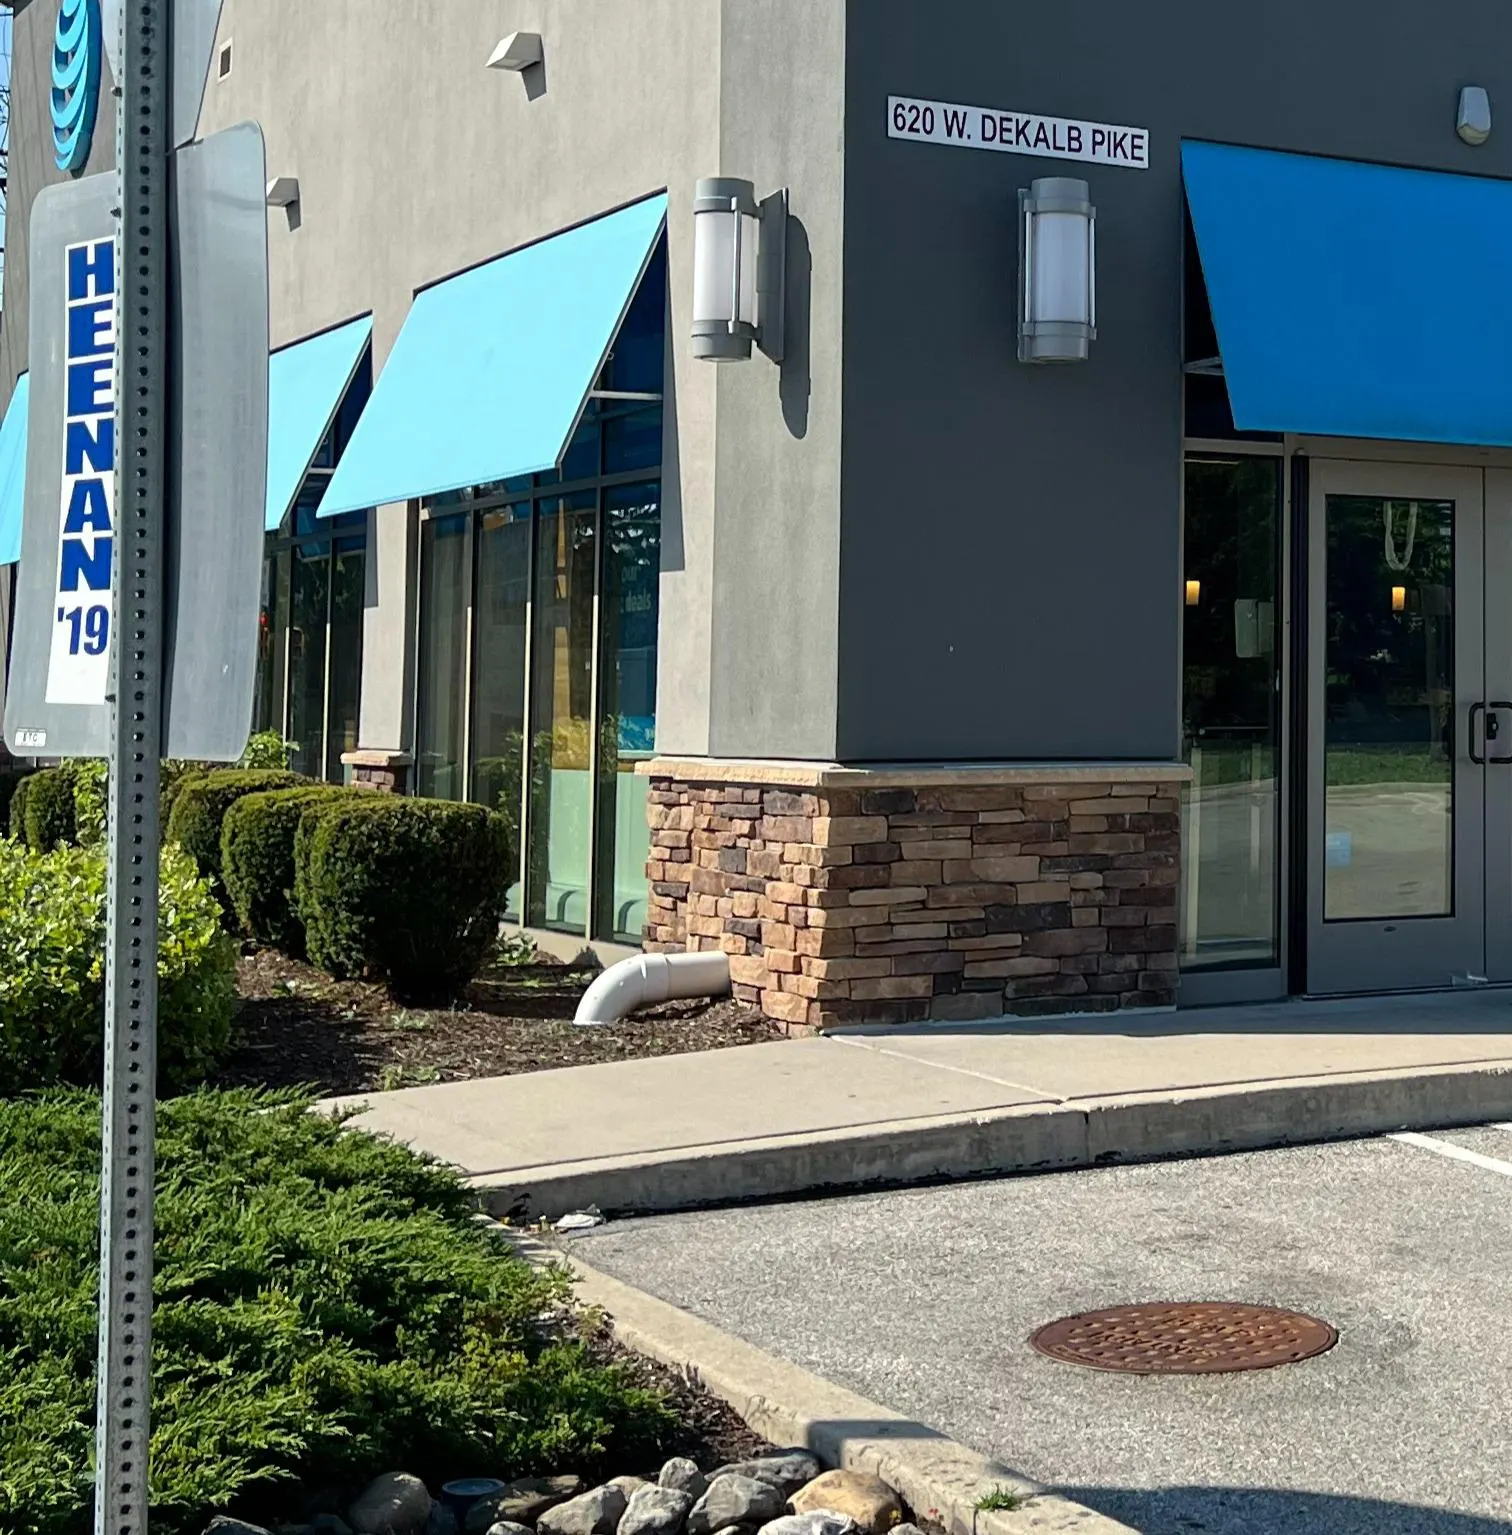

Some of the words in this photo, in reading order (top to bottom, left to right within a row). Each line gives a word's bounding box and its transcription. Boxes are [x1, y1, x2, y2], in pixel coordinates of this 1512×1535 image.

[892, 102, 935, 136] 620
[942, 108, 972, 141] W.
[980, 113, 1083, 154] DEKALB
[1091, 128, 1146, 162] PIKE
[58, 239, 116, 593] HEENAN
[57, 604, 109, 656] '19
